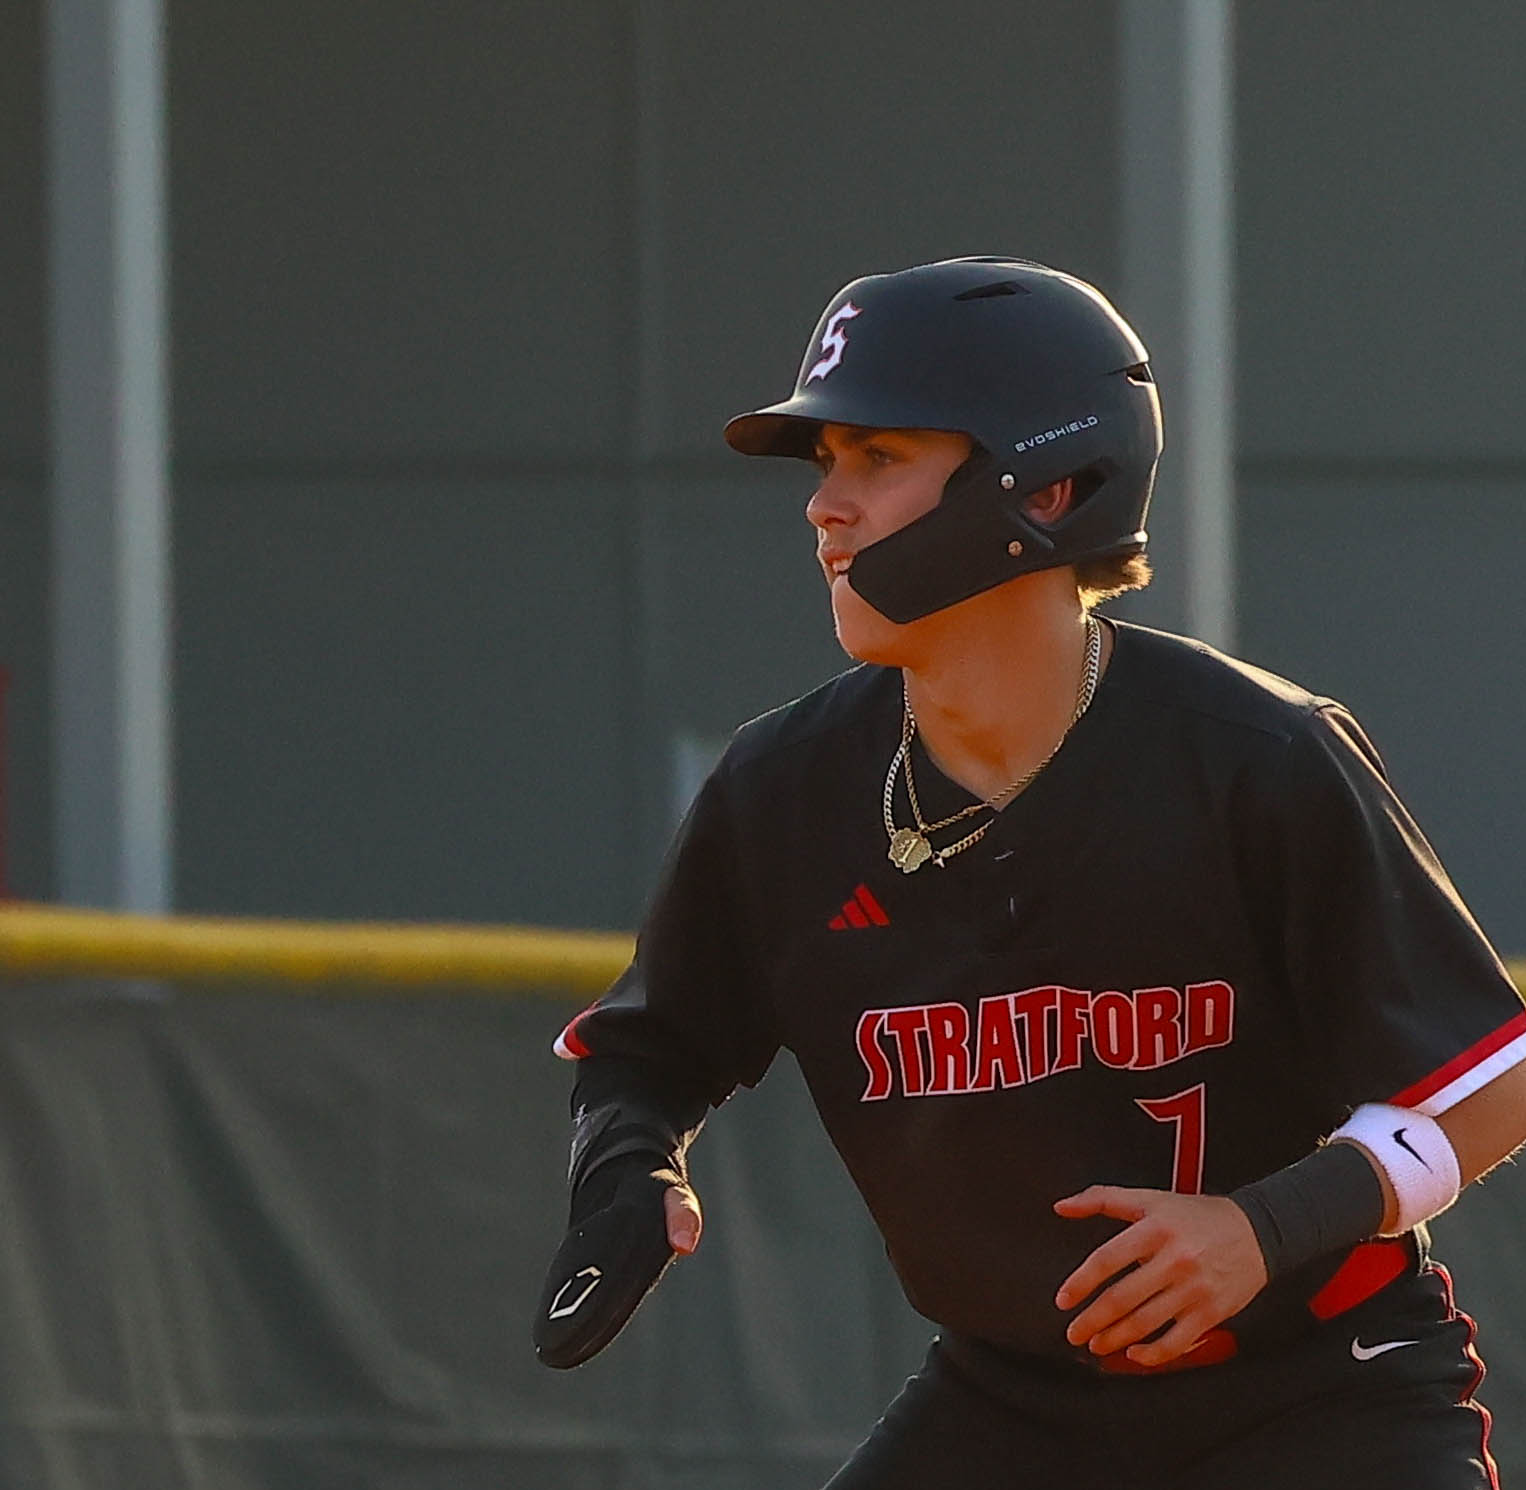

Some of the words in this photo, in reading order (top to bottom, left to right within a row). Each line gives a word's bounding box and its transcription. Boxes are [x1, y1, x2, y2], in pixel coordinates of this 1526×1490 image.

[805, 300, 863, 387] S
[855, 979, 1235, 1102] STRATFORD
[1133, 1081, 1206, 1196] 1
